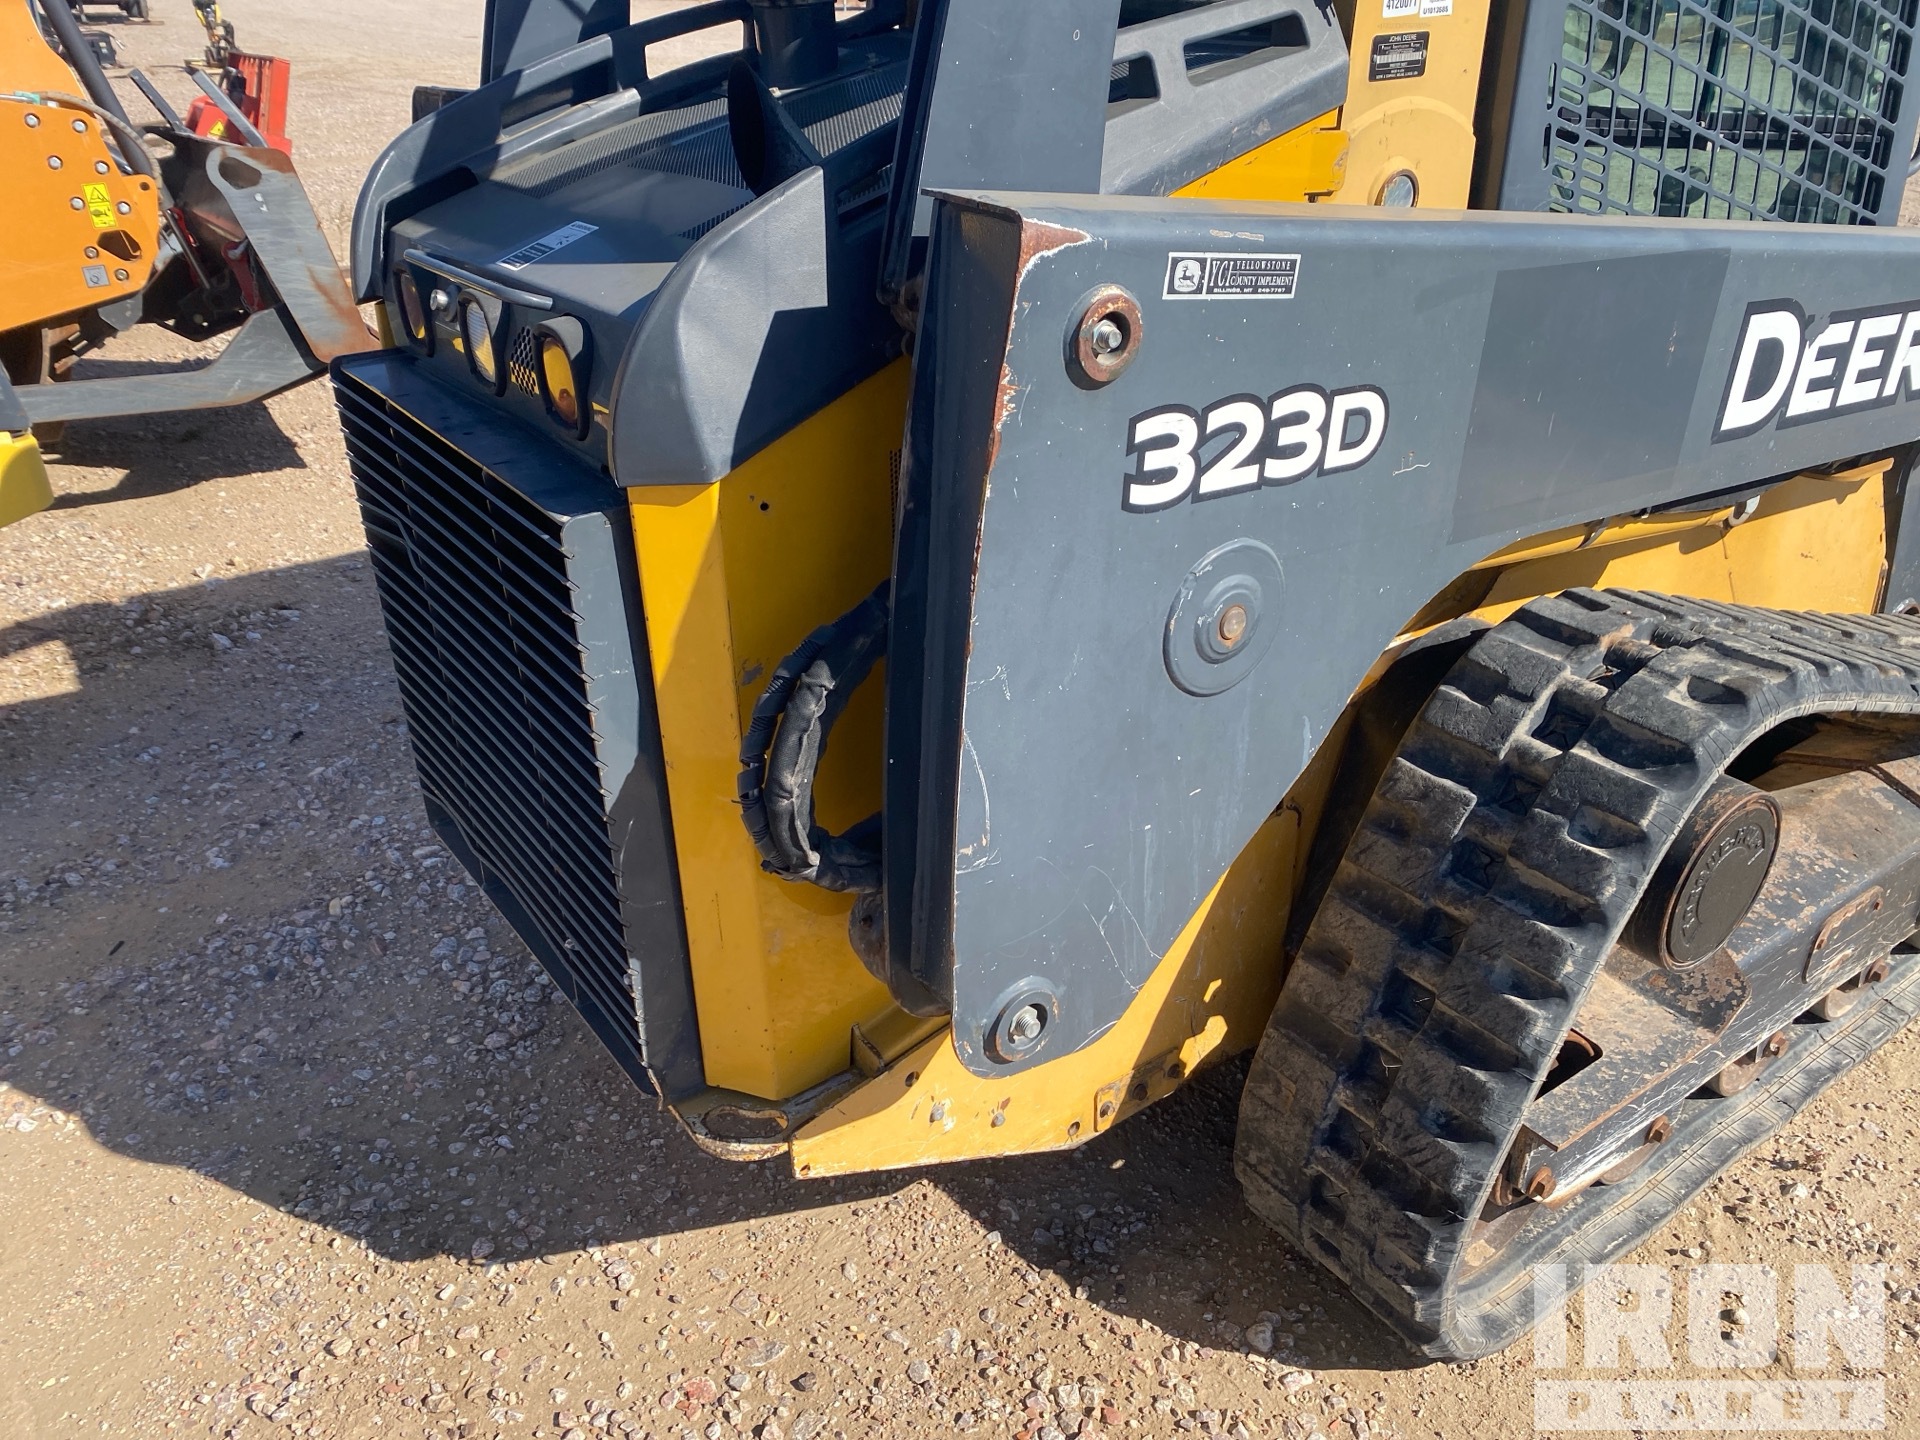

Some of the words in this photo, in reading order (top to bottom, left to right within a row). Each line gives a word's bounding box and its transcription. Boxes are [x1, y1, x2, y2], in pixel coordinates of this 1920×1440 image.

[1209, 260, 1235, 287] YCI
[1236, 261, 1291, 270] YELLOWSTONE
[1230, 275, 1257, 286] COUNTY
[1257, 276, 1293, 286] IMPLEMENT
[1122, 384, 1388, 513] 323D
